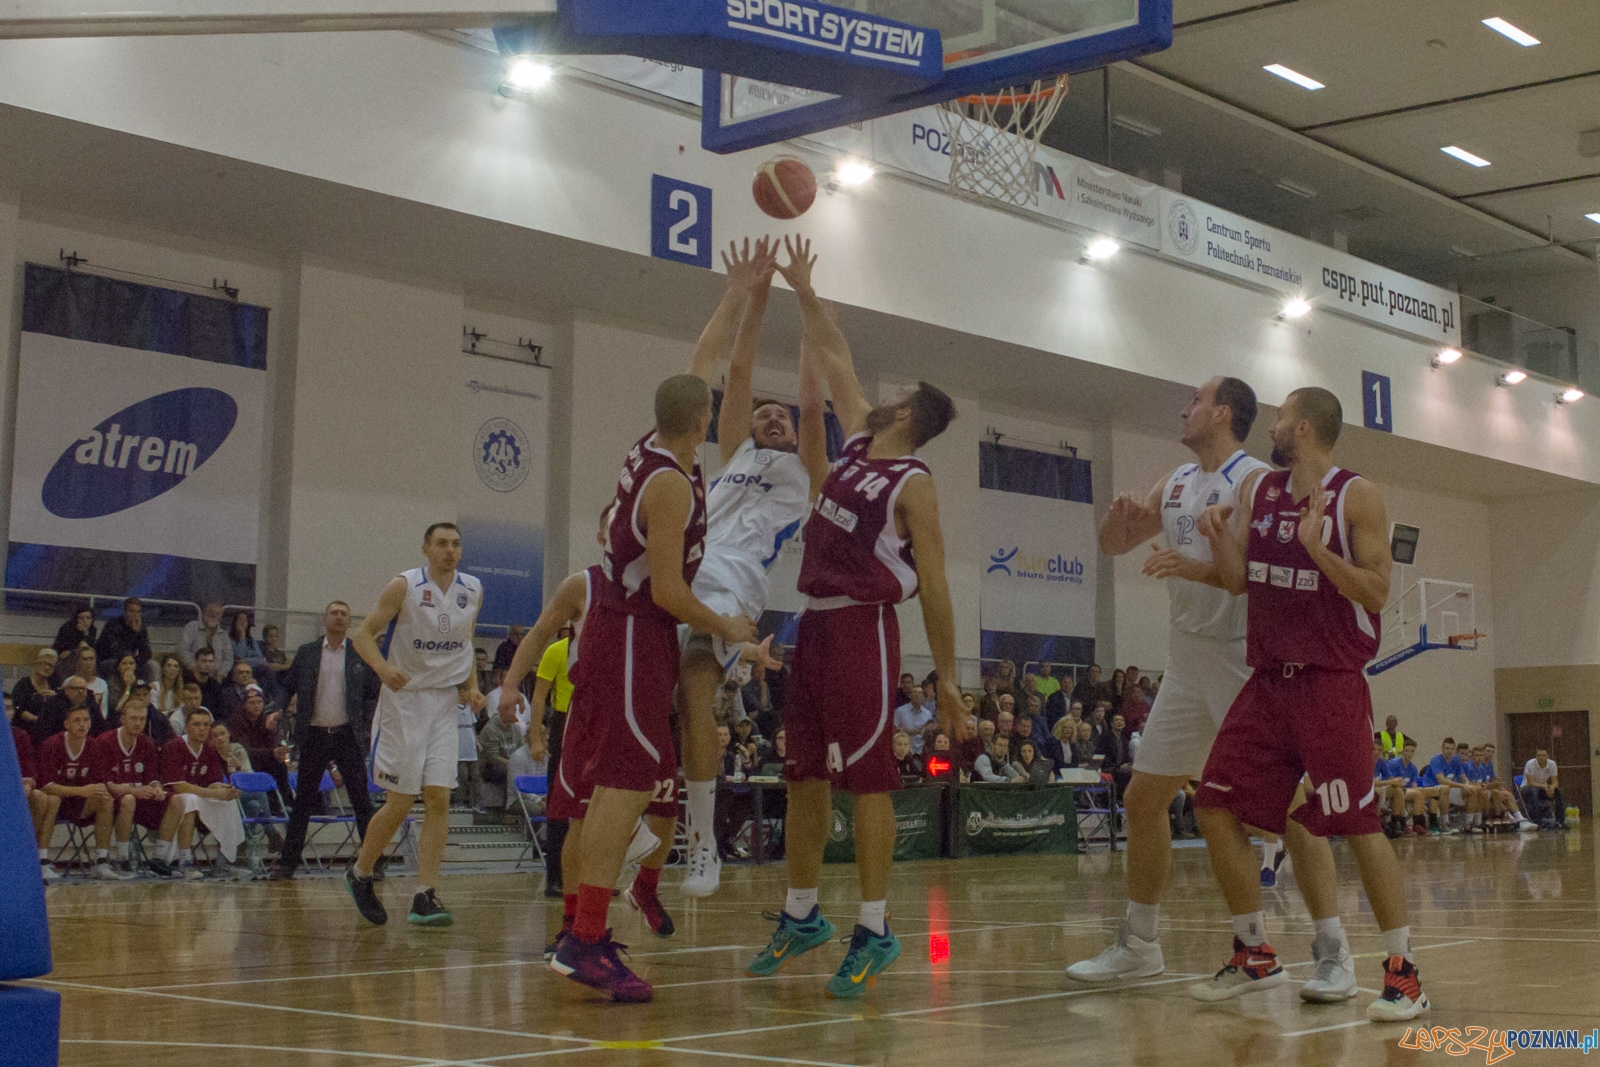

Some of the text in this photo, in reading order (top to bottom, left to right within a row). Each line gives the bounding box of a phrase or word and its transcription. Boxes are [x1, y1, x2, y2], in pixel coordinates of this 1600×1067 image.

[1076, 176, 1143, 208] Ministerstwo Nauki
[1081, 193, 1121, 217] Szkolnictwa
[668, 188, 699, 256] 2
[1206, 216, 1271, 253] Centrum Sportu
[1206, 241, 1303, 289] Politechniki Poznańskiej
[1322, 266, 1455, 333] cspp.put.poznan.pl
[1372, 380, 1384, 425] 1
[75, 422, 198, 476] atrem
[854, 471, 890, 502] 14
[1176, 514, 1195, 545] 12
[1017, 570, 1044, 580] biuro
[437, 613, 449, 634] 8
[1315, 778, 1350, 816] 10
